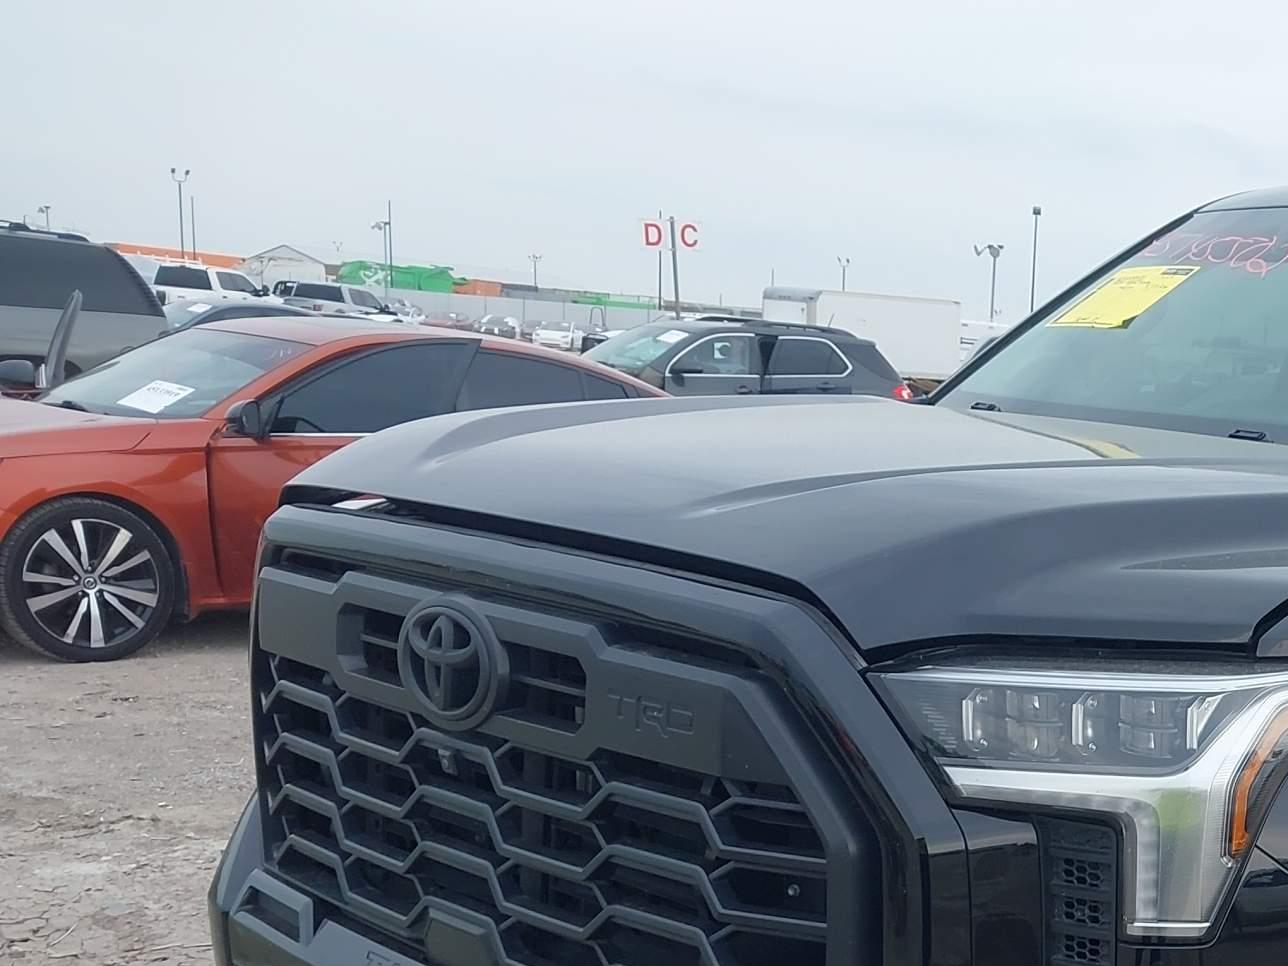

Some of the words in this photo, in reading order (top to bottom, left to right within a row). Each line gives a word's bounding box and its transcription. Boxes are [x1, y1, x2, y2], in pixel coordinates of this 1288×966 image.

[643, 222, 662, 247] D
[680, 223, 698, 248] C
[606, 693, 697, 738] TRD
